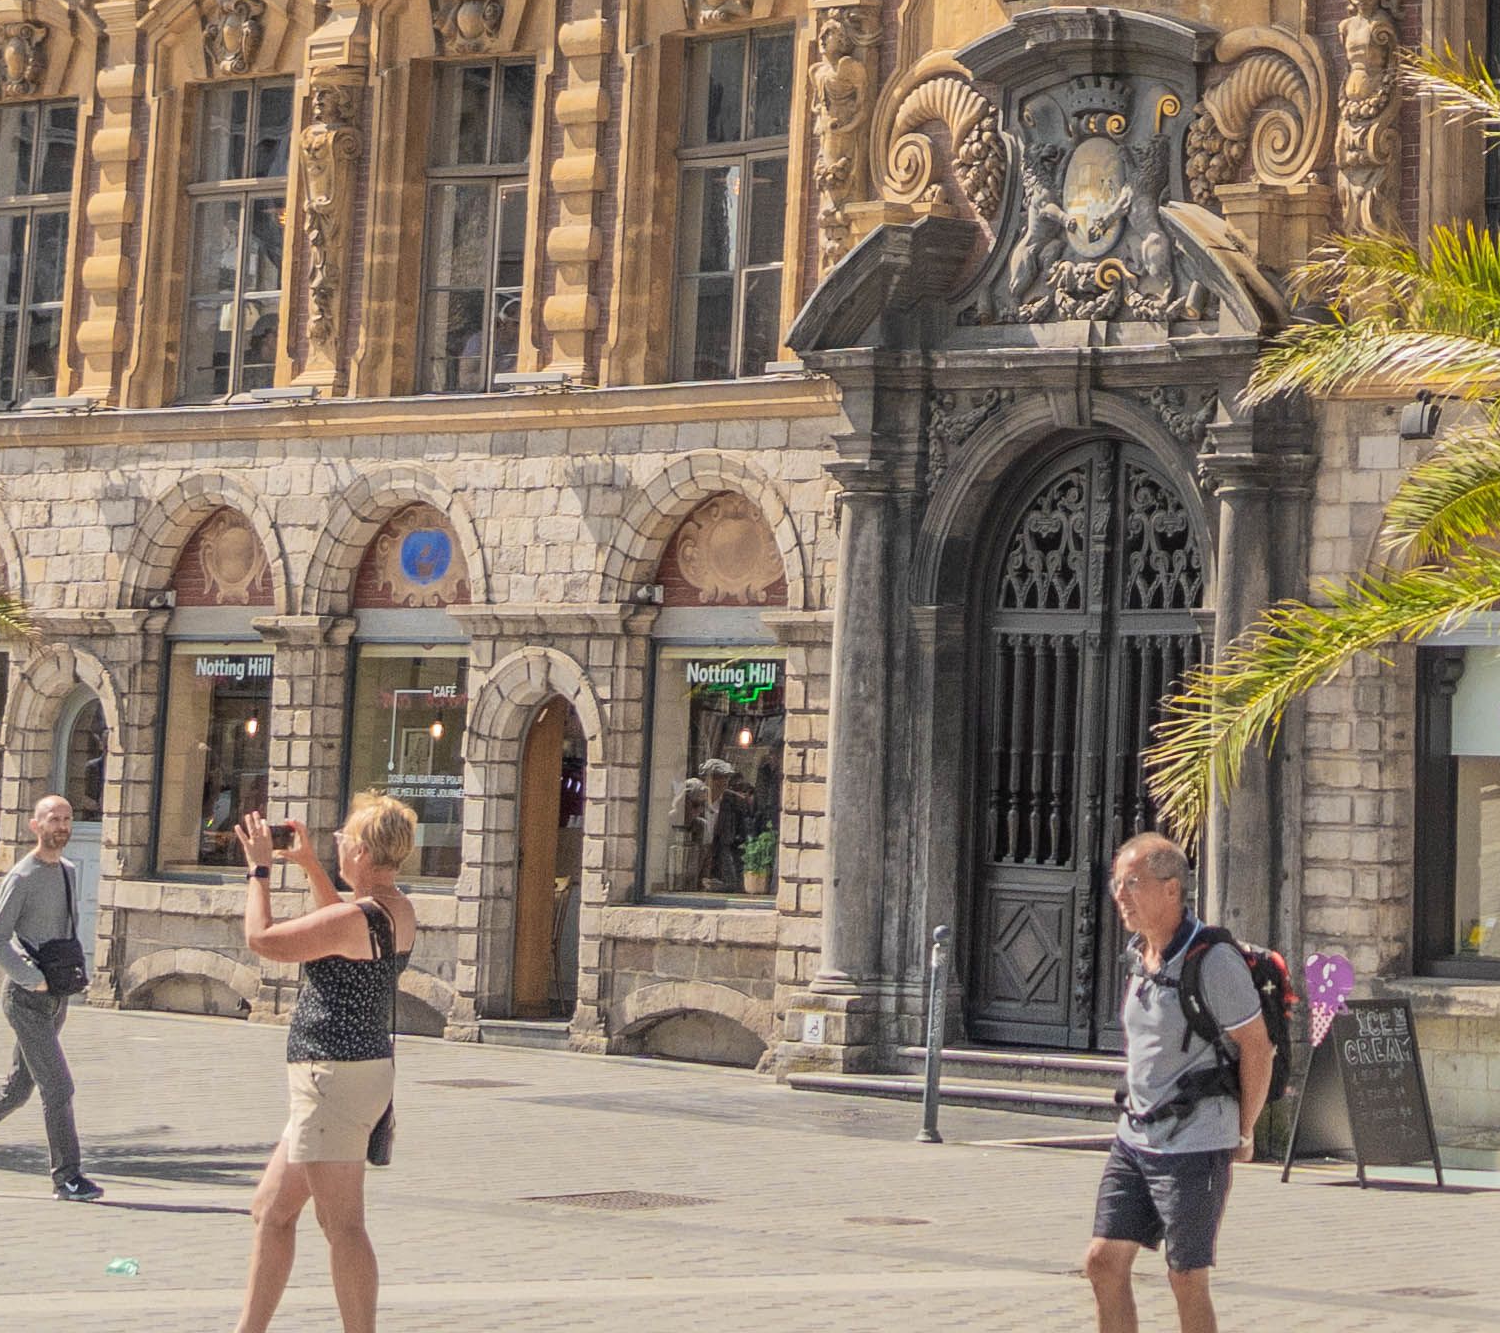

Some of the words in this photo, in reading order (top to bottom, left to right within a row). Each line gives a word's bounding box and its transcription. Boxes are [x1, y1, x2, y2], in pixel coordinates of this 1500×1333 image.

[196, 657, 245, 680] Notting
[248, 657, 271, 676] Hill
[686, 662, 745, 687] Notting
[748, 662, 776, 683] Hill
[433, 683, 457, 698] CAFÉ
[1356, 1010, 1393, 1037] ICE
[1344, 1036, 1413, 1064] CREAM
